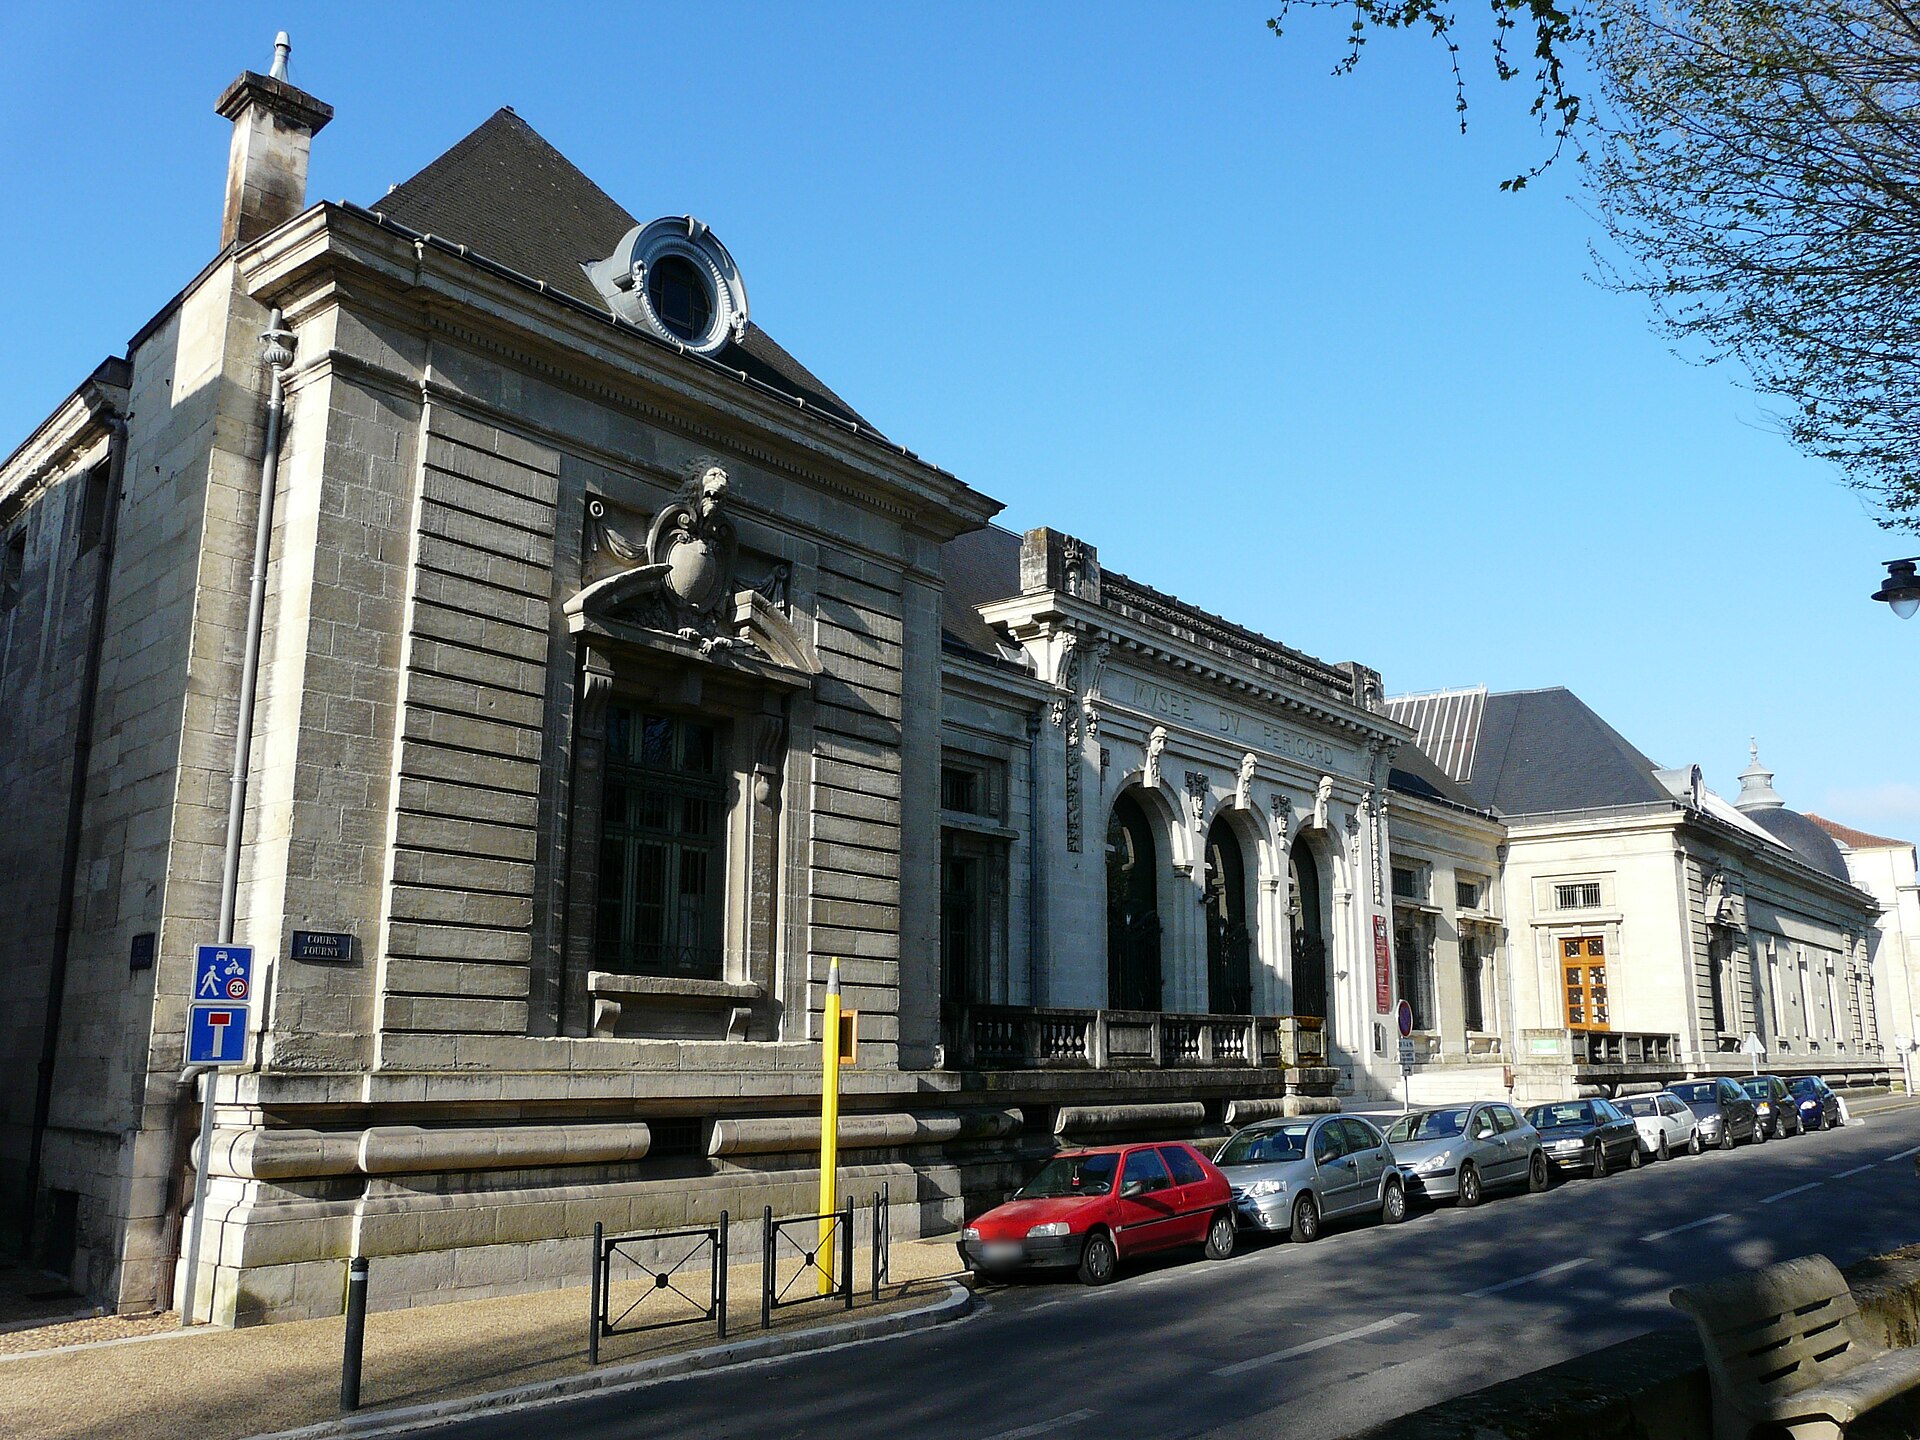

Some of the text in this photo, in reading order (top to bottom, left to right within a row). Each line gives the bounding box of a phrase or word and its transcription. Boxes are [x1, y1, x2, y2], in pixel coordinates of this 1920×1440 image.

[1263, 725, 1334, 766] PERIGORD
[307, 935, 338, 945] COURS
[302, 946, 340, 957] TOURNY
[231, 984, 244, 993] 20
